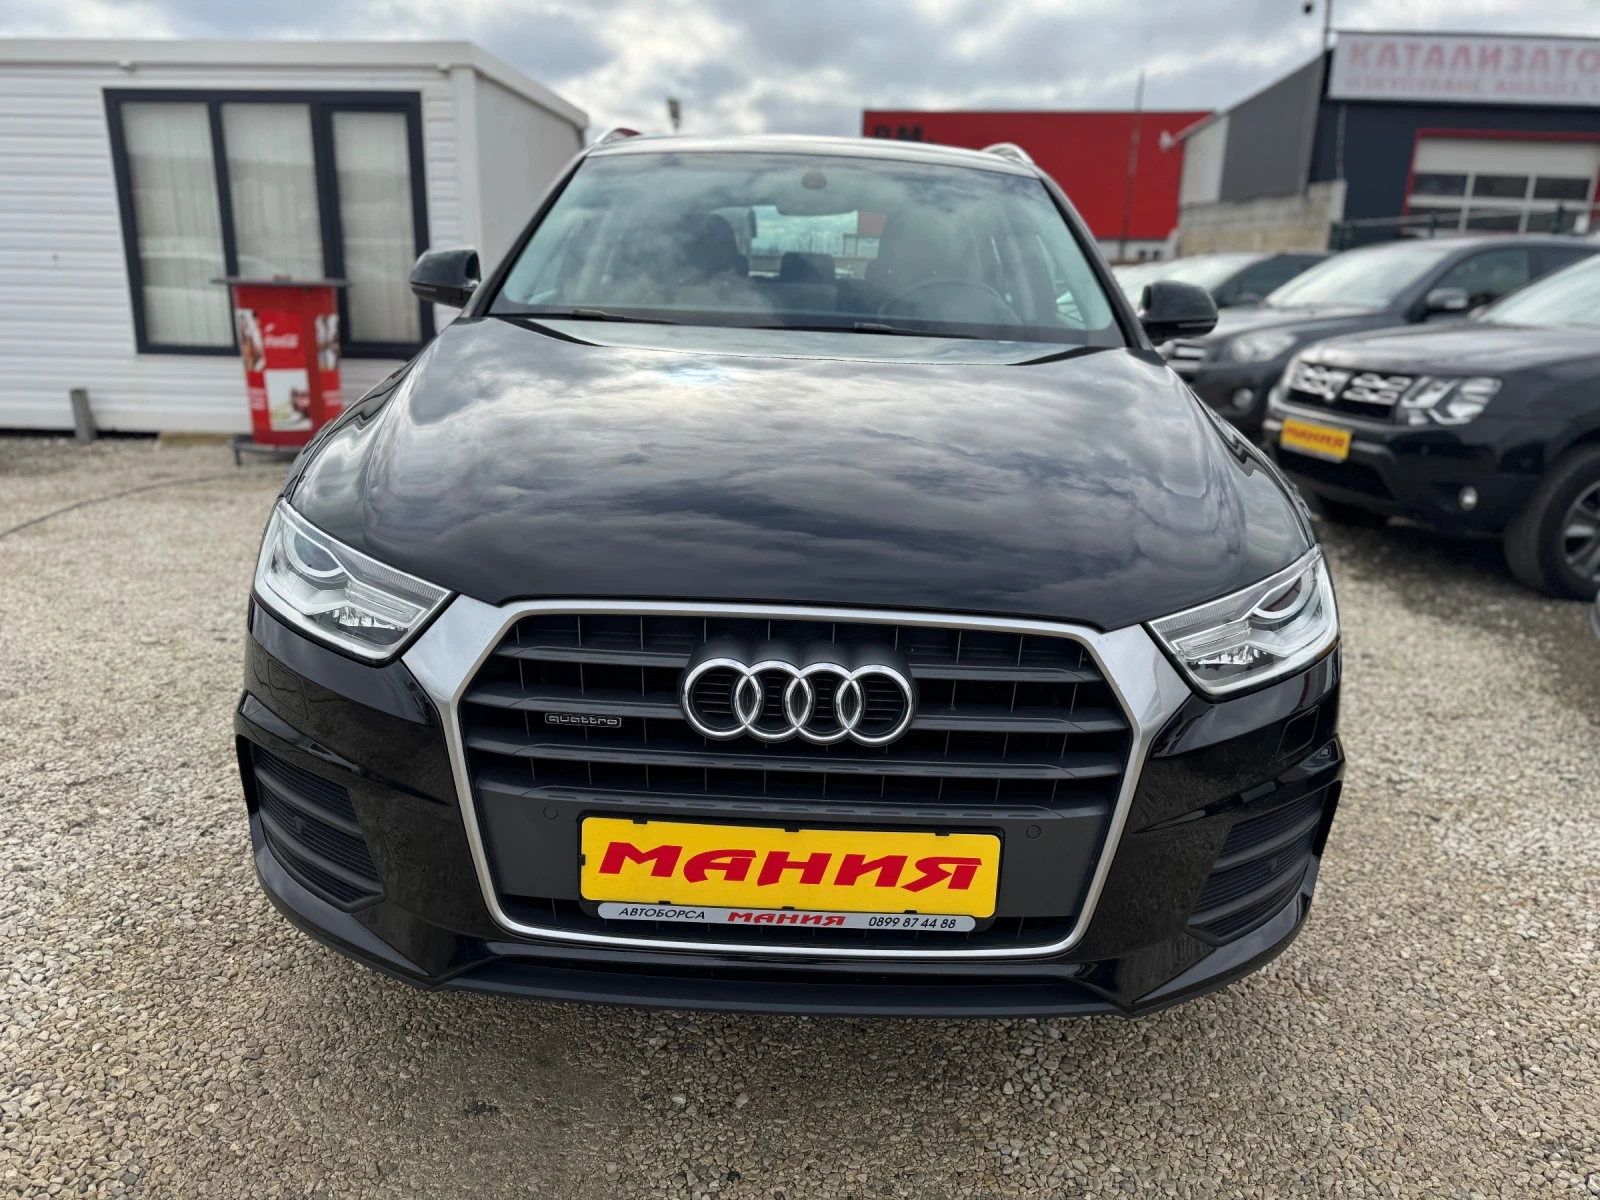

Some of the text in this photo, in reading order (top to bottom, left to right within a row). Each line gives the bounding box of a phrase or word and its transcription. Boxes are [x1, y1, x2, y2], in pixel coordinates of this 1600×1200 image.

[548, 715, 618, 725] quattro
[598, 841, 982, 893] МАНИЯ
[618, 907, 957, 929] АВТОБОРСА МАНИЯ 0899 87 44 88
